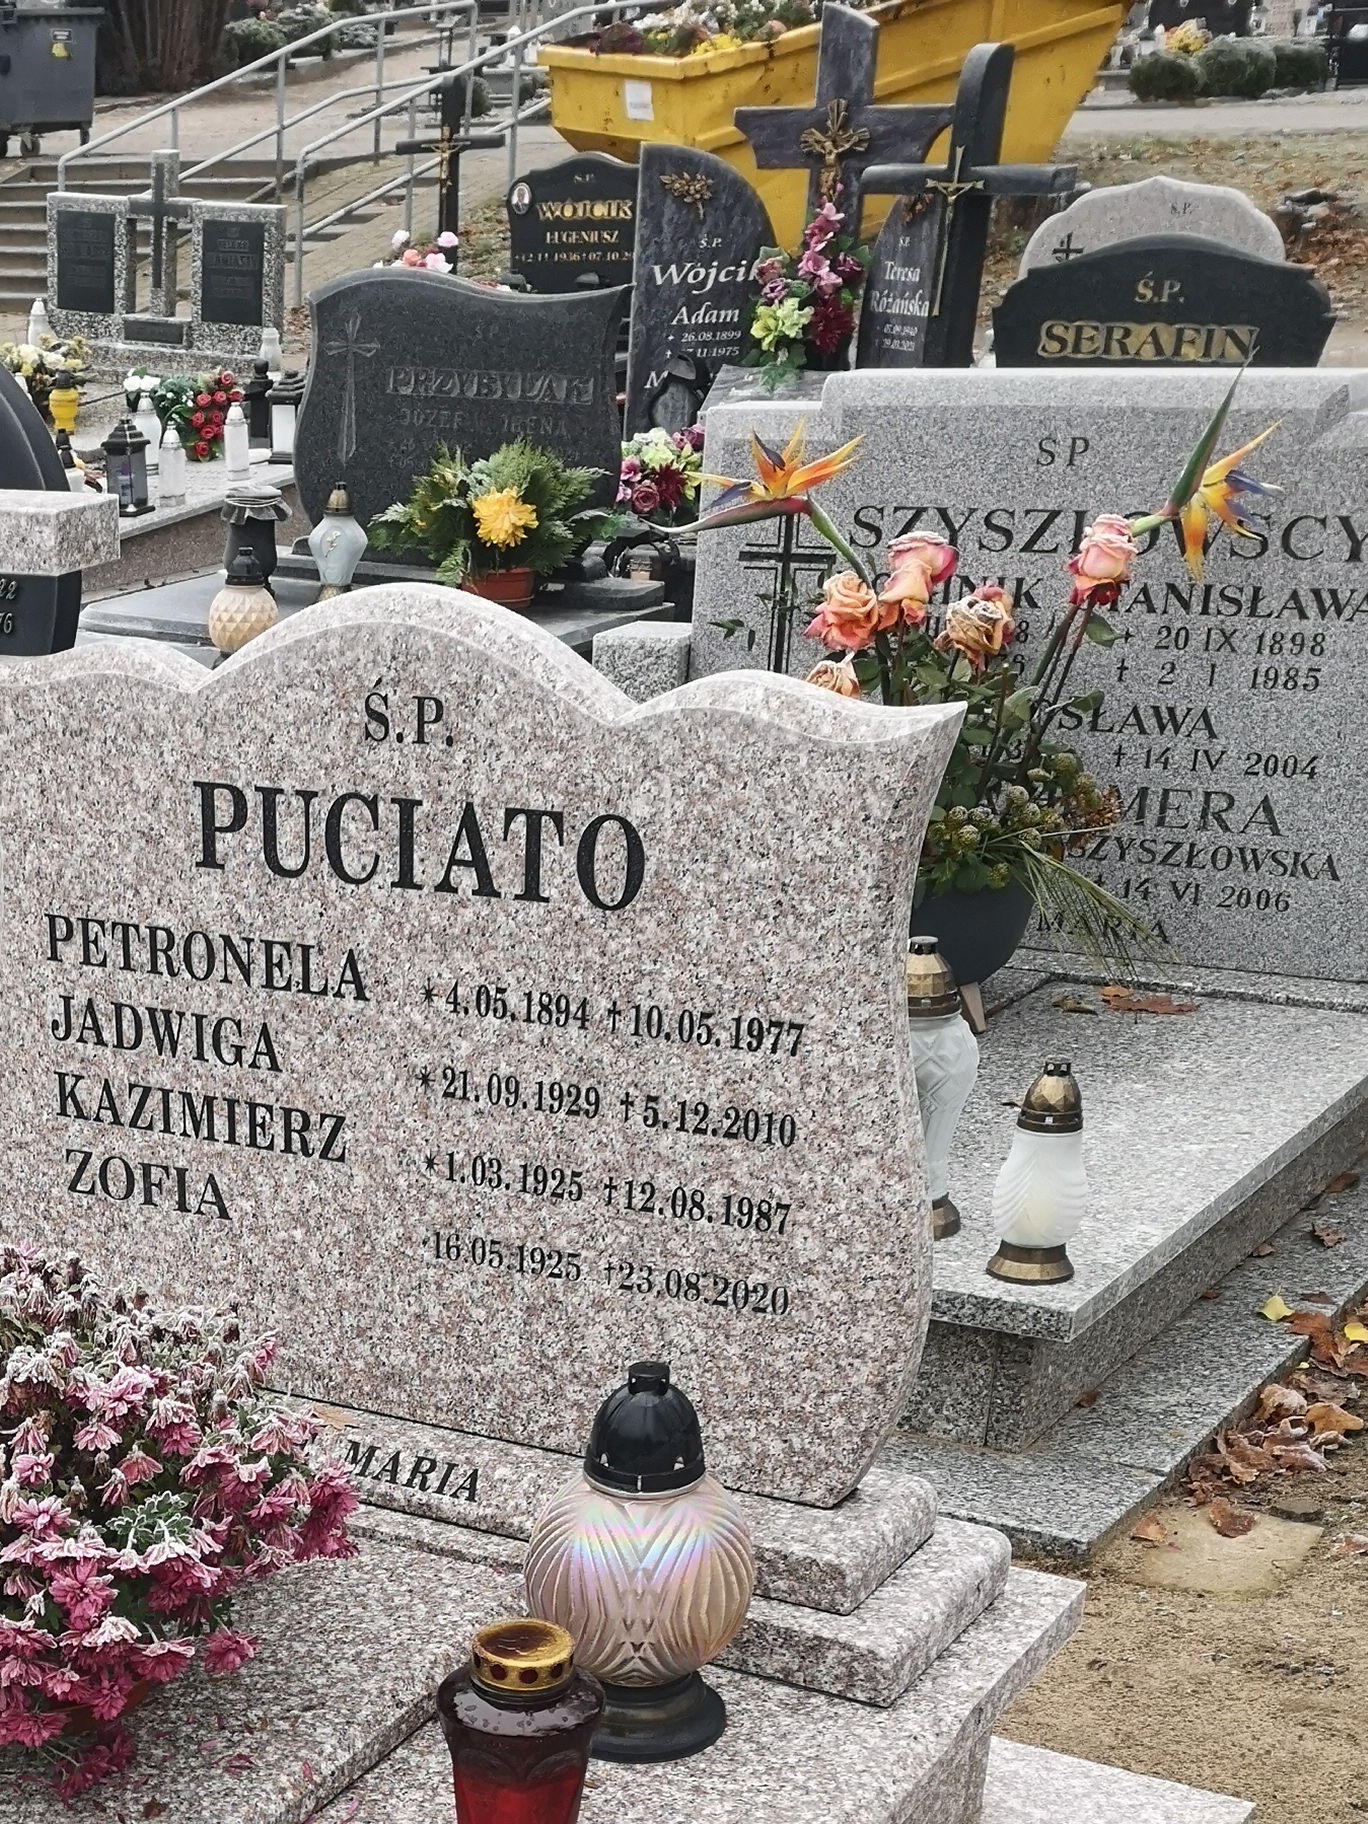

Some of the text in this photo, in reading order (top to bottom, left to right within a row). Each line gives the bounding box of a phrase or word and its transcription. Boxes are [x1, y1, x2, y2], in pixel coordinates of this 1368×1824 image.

[537, 198, 633, 221] WÓJCIK
[546, 230, 620, 244] EUGENIUSZ
[884, 261, 921, 282] Teresa
[1135, 270, 1185, 304] Ś.P.
[671, 302, 740, 326] Adam
[871, 289, 930, 317] Różańska
[681, 331, 742, 343] 26.08.1899
[1038, 320, 1260, 363] SERAFIN
[1155, 625, 1327, 658] 20 IX 1898
[1157, 661, 1177, 686] 2
[1250, 665, 1323, 692] 1985
[363, 677, 456, 748] Ś.P.
[1143, 746, 1320, 780] 14 IV 2004
[193, 779, 646, 912] PUCIATO
[1122, 877, 1292, 913] 14 VI 2006
[44, 912, 370, 1001] PETRONELA
[50, 993, 283, 1073] JADWIGA
[53, 1070, 347, 1164] KAZIMIERZ
[65, 1148, 232, 1221] ZOFIA
[343, 1439, 482, 1503] MARIA
